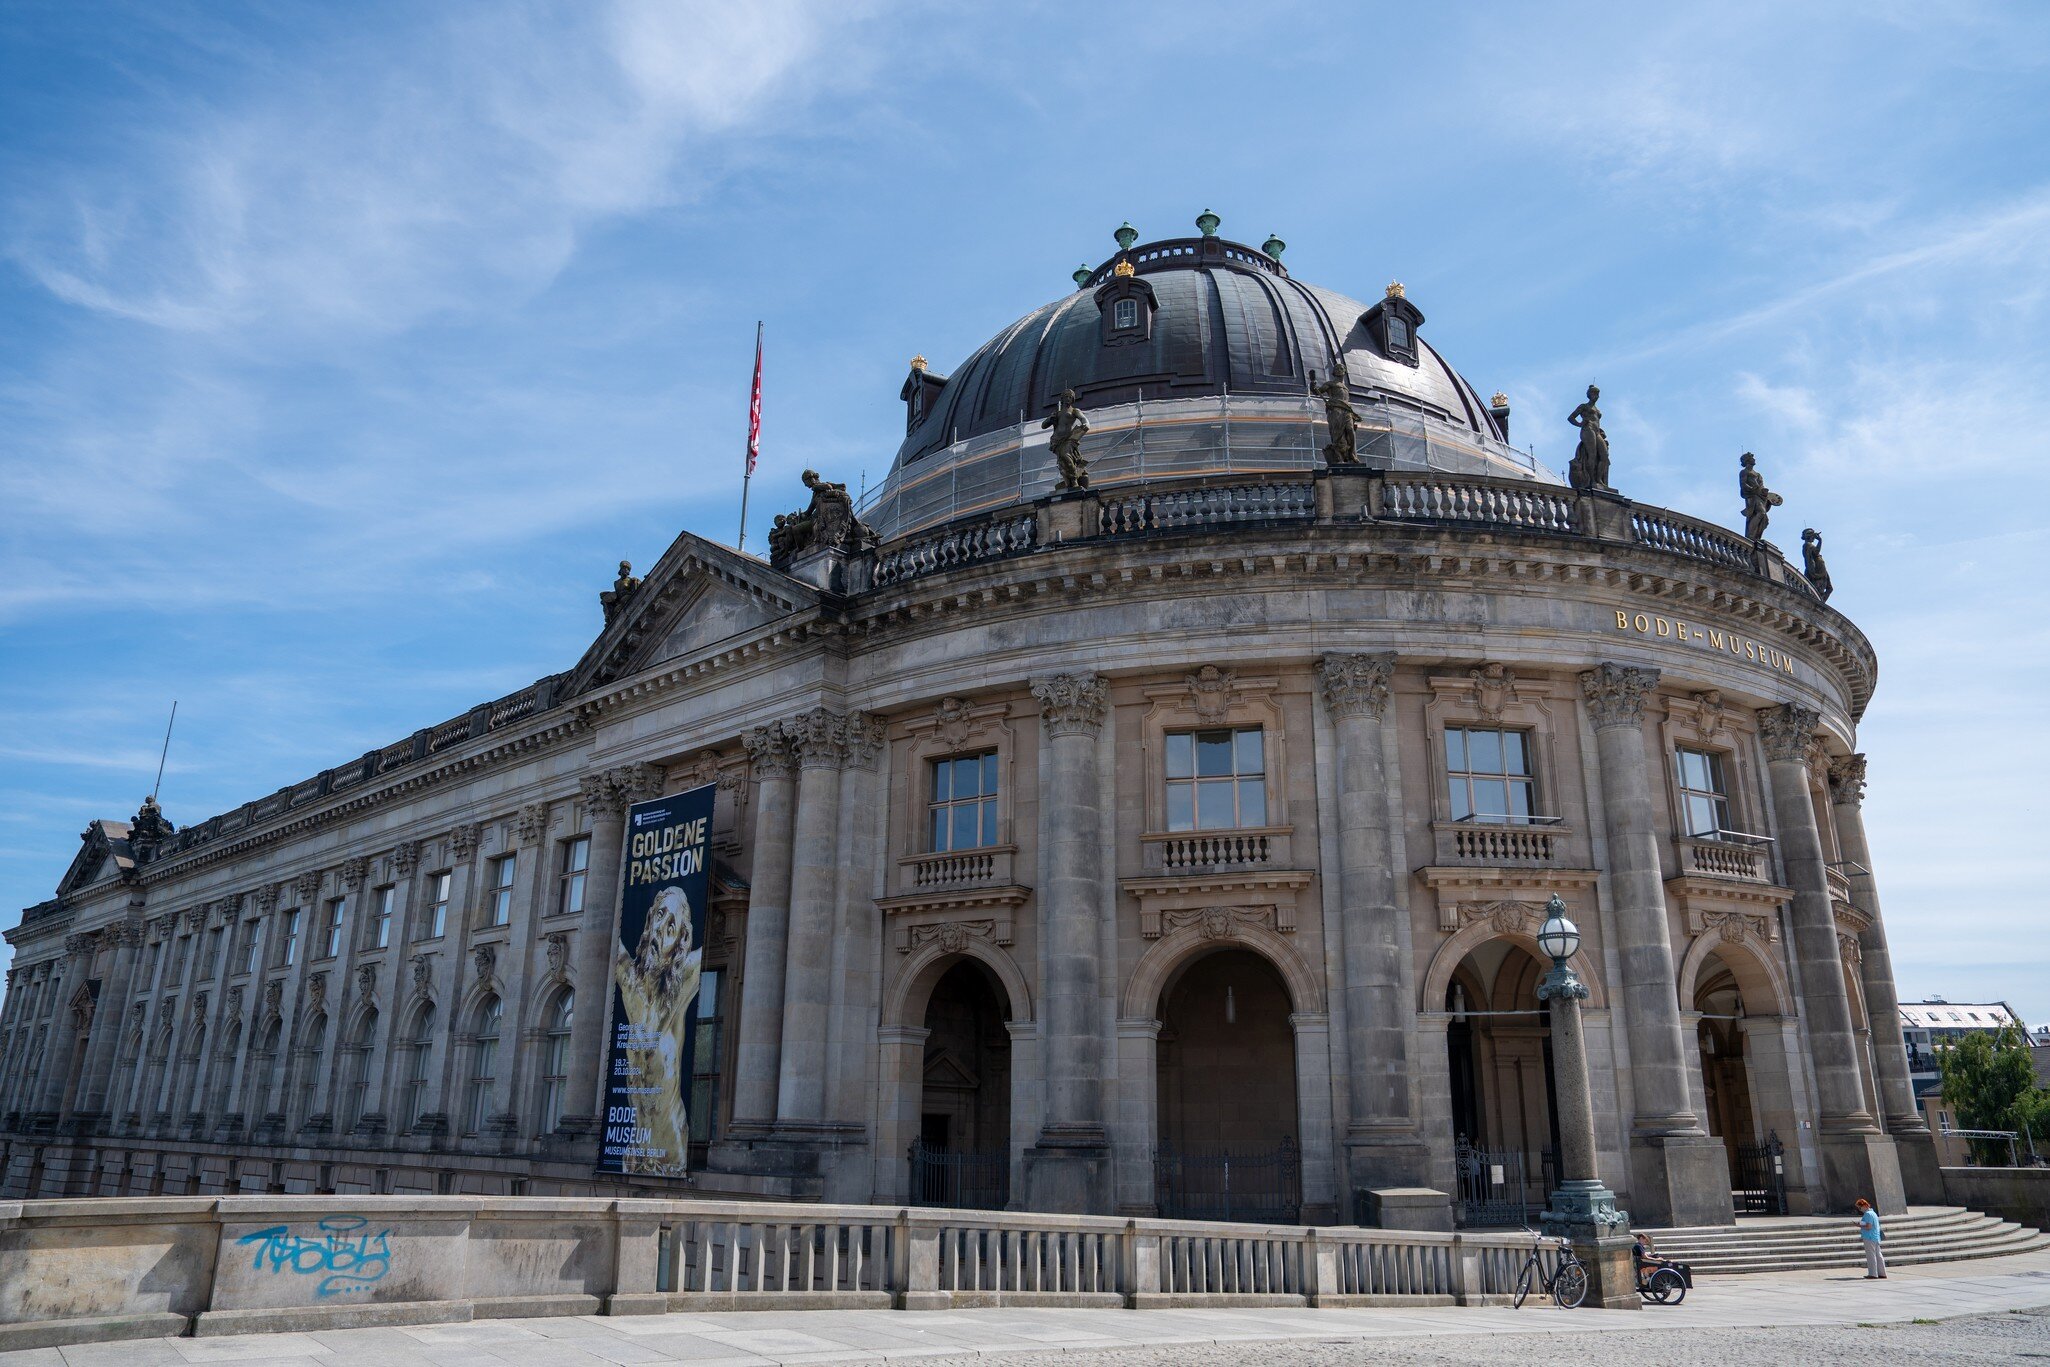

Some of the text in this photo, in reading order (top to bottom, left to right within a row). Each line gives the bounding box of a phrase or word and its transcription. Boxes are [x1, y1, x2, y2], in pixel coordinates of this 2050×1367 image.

[632, 817, 707, 858] GOLDENE
[630, 846, 703, 886] PASSION
[617, 1032, 628, 1040] und
[609, 1106, 637, 1123] BODE
[606, 1126, 652, 1144] MUSEUM
